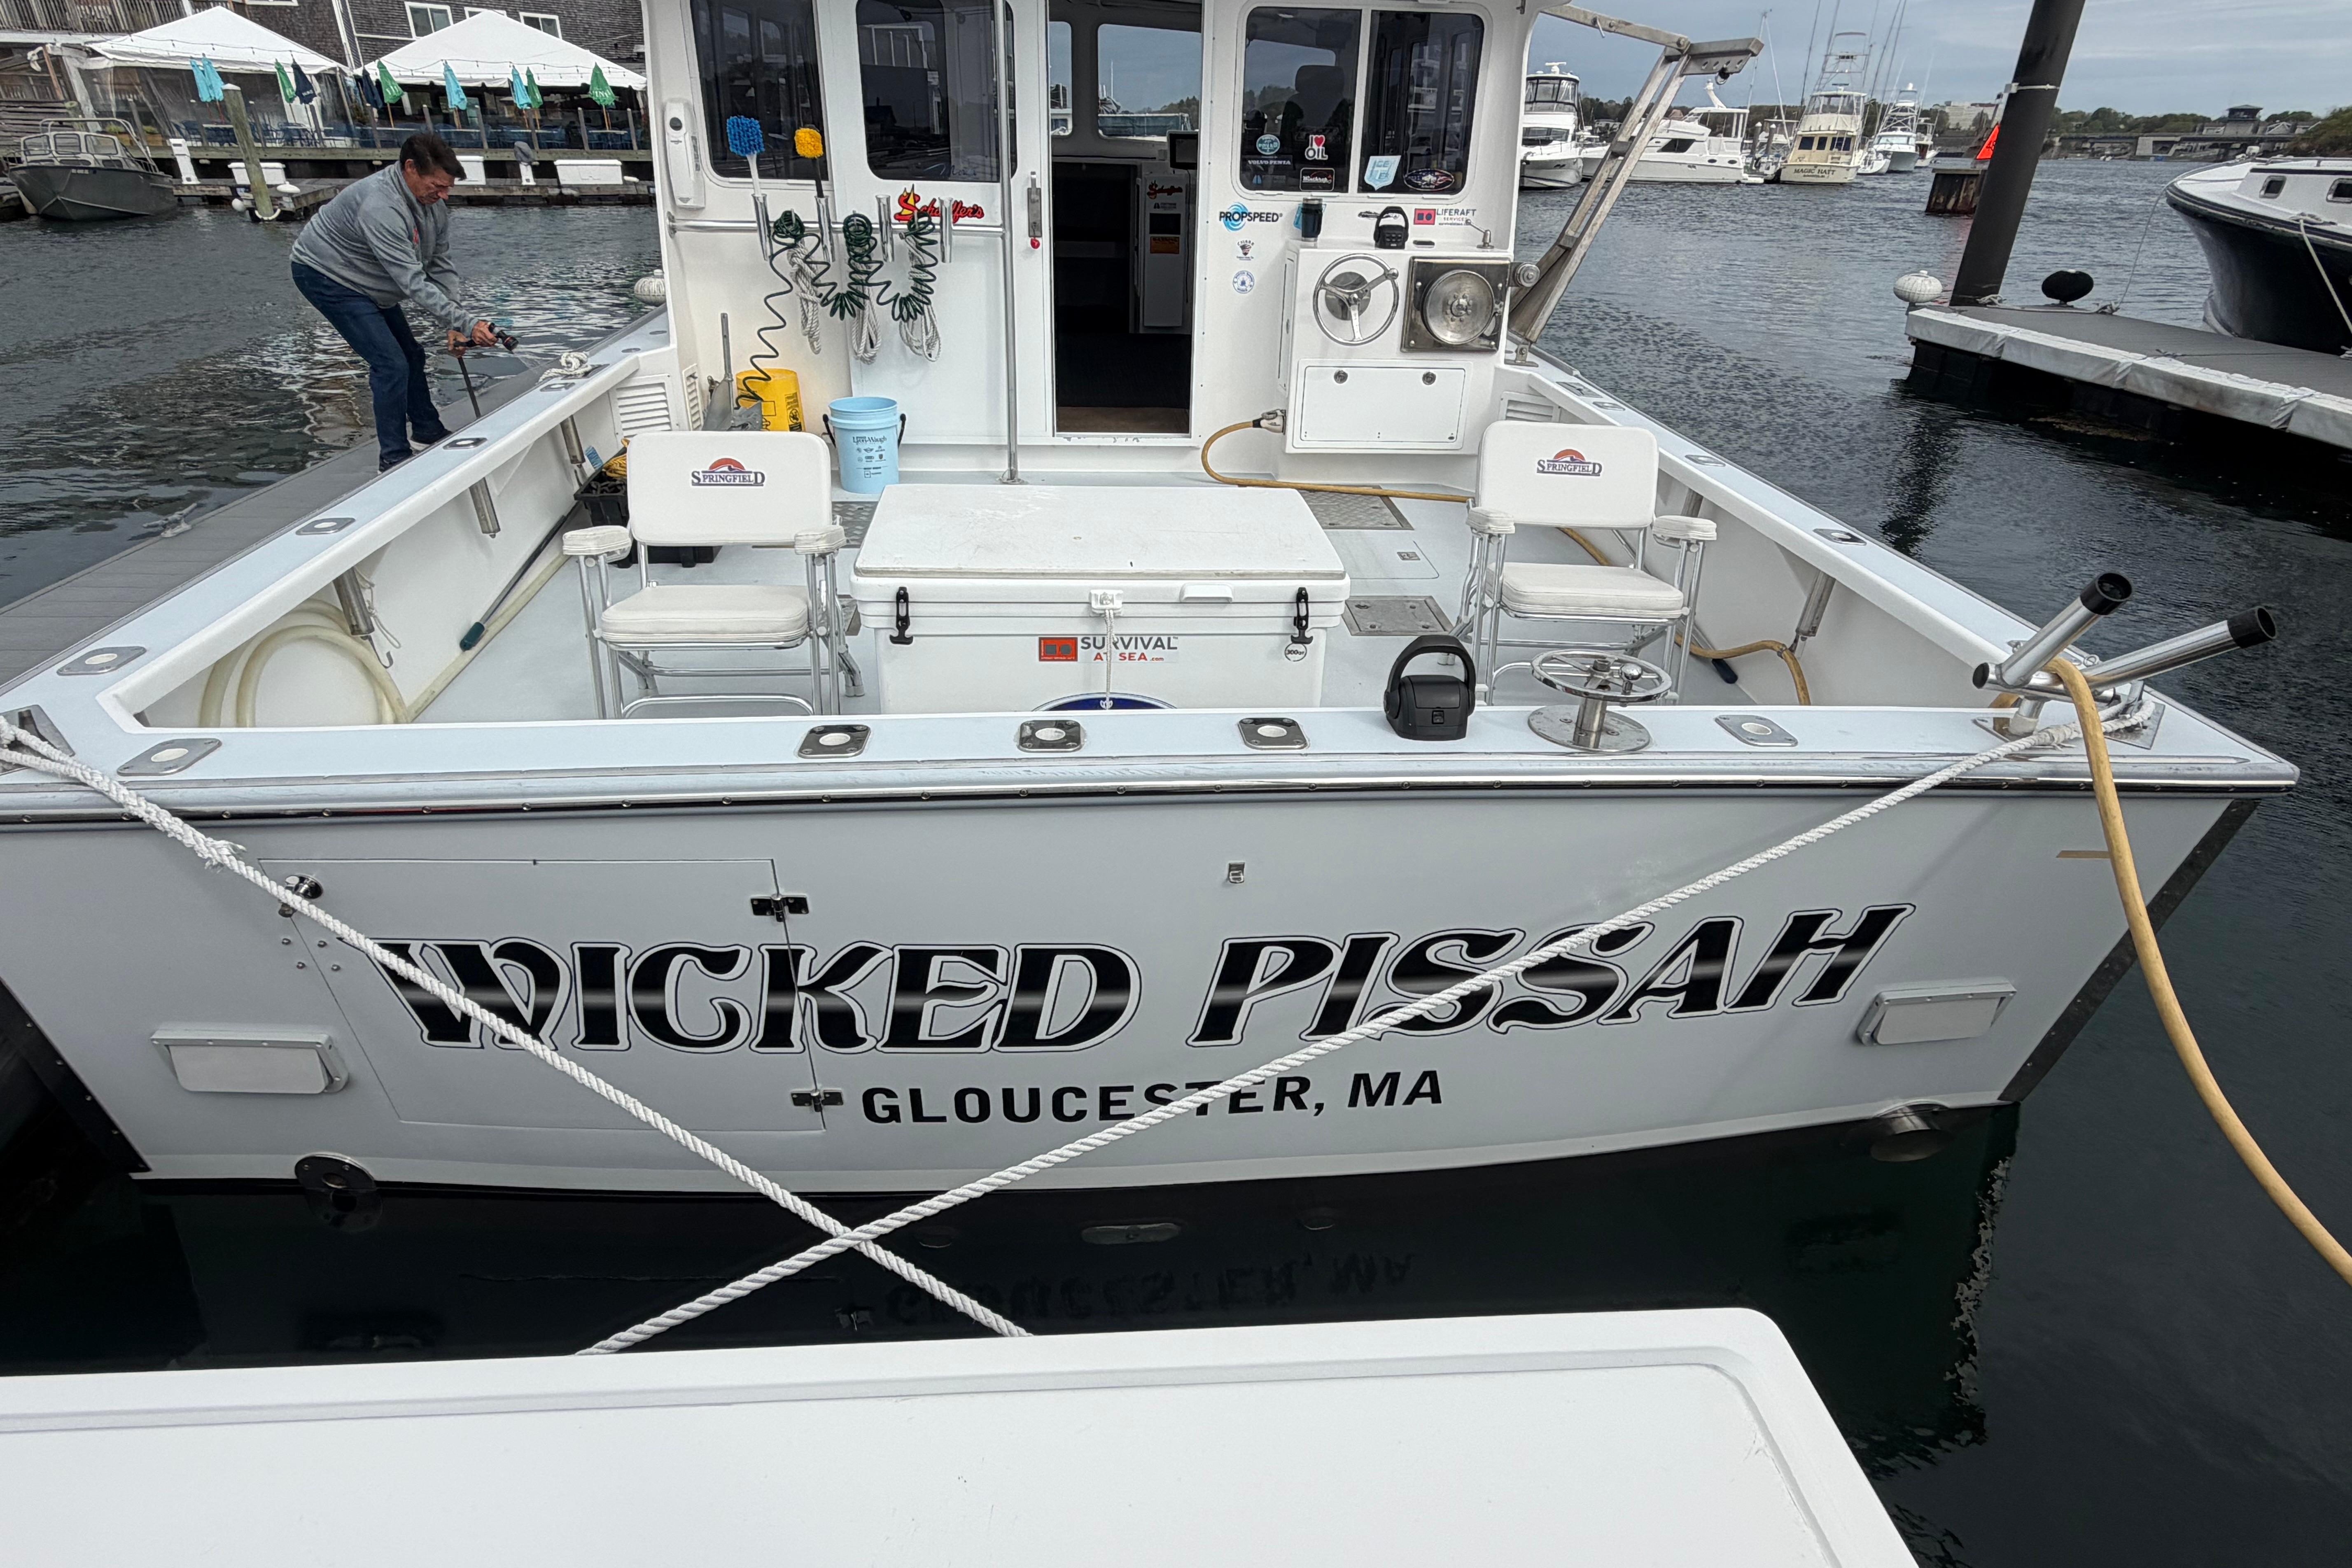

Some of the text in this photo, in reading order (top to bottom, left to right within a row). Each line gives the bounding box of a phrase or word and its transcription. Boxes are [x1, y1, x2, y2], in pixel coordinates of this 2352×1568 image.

[1306, 147, 1328, 159] OIL
[1219, 211, 1279, 222] PROPSPEED
[1537, 459, 1603, 475] SPRINGFIELD
[691, 470, 765, 485] SPRINGFIELD
[1080, 637, 1178, 650] SURVIVAL
[1119, 652, 1148, 661] SEA
[336, 903, 1916, 1053] WICKED PISSAH
[862, 1070, 1442, 1123] GLOUCESTER, MA
